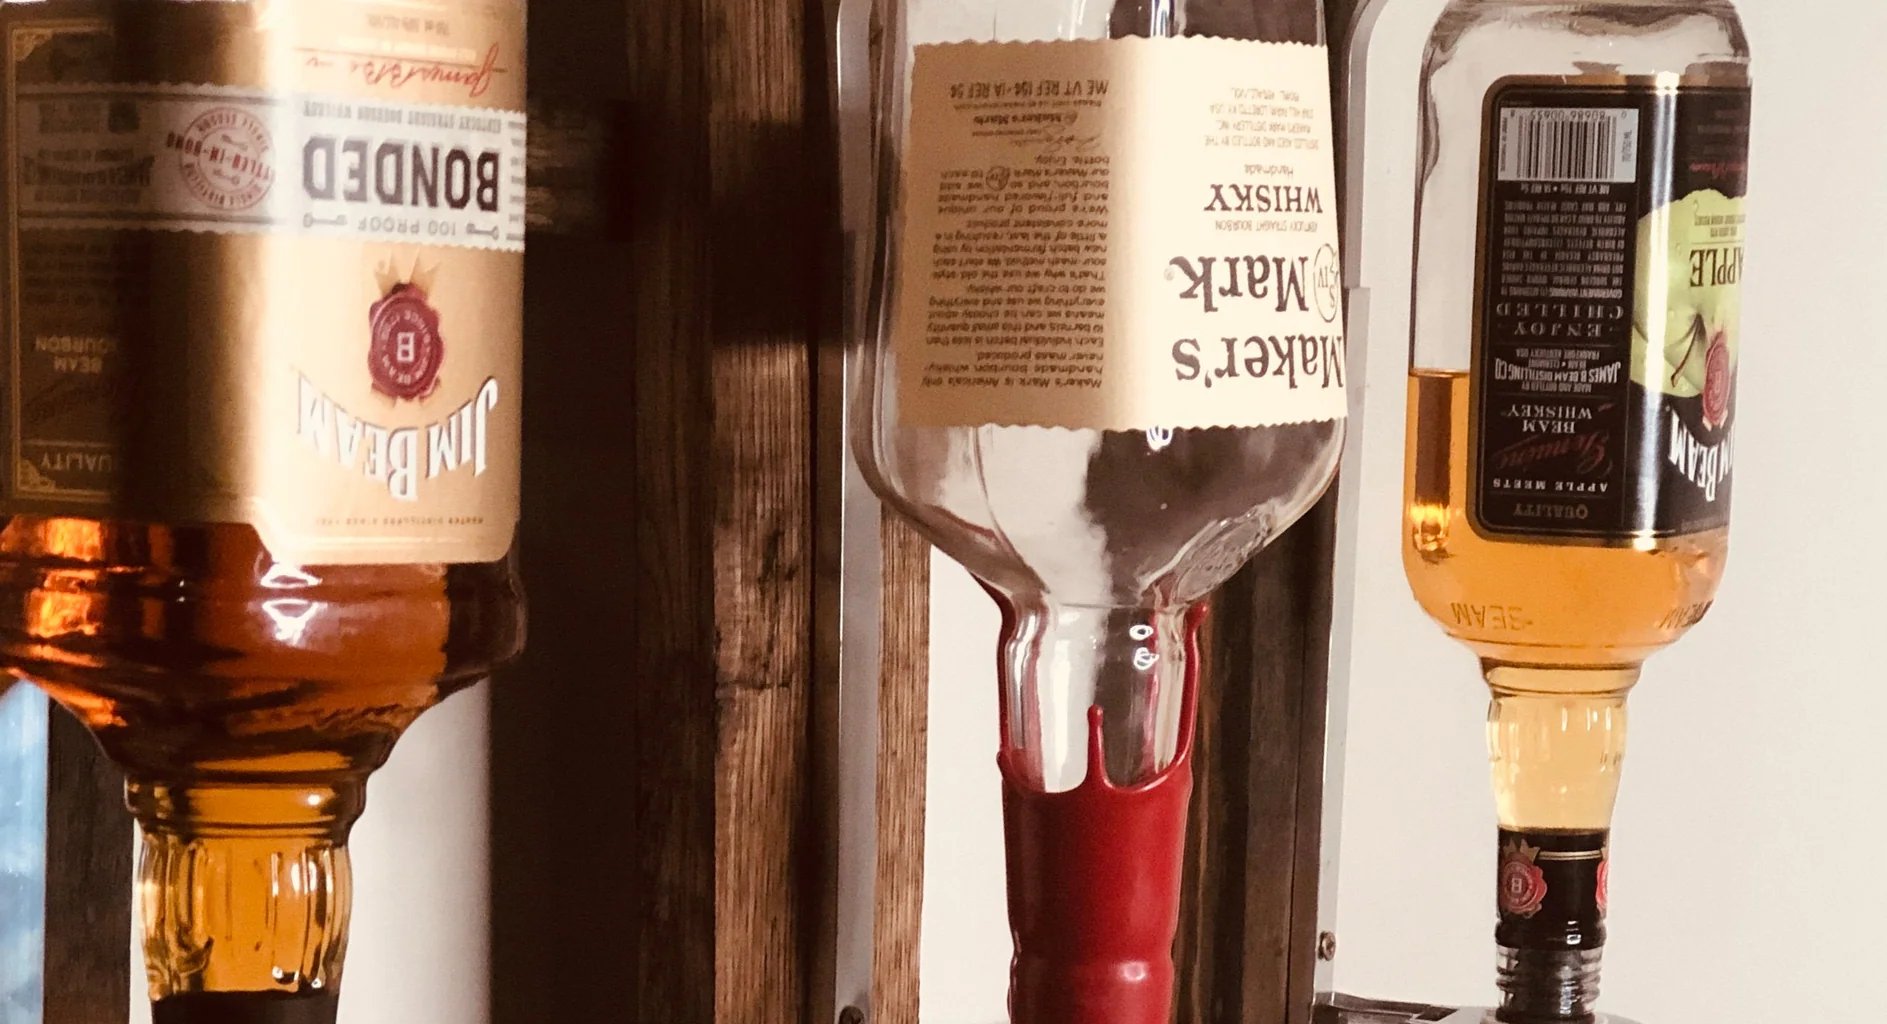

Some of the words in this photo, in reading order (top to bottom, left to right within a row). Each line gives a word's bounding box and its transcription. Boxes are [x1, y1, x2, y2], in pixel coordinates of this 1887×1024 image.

[967, 82, 990, 98] REF
[994, 82, 1005, 97] IA
[1037, 80, 1059, 96] REF
[1064, 80, 1082, 95] VT
[1088, 80, 1107, 96] ME
[303, 137, 500, 212] BONDED
[1244, 164, 1293, 177] Handmade
[938, 193, 999, 201] handmade
[1083, 193, 1108, 201] and
[1204, 184, 1322, 214] WHISKY
[938, 205, 976, 214] unique
[984, 205, 1004, 214] our
[1010, 205, 1023, 214] of
[1029, 204, 1066, 213] proud
[1072, 205, 1108, 214] We're
[358, 217, 420, 234] PROOF
[428, 220, 456, 236] 100
[1690, 246, 1744, 287] APPLE
[1168, 255, 1309, 313] Mark
[929, 297, 980, 306] everything
[983, 297, 1002, 306] and
[1007, 297, 1024, 306] use
[1028, 297, 1041, 306] we
[1045, 297, 1105, 306] everything
[1496, 303, 1624, 319] CHILLED
[927, 322, 970, 332] quantity
[972, 323, 999, 333] small
[1003, 323, 1021, 333] this
[1025, 323, 1046, 333] and
[1050, 323, 1091, 333] barrels
[1514, 321, 1602, 337] ENJOY
[926, 336, 949, 346] than
[975, 336, 982, 346] is
[985, 336, 1017, 346] batch
[1020, 336, 1073, 346] individual
[1076, 336, 1103, 346] Each
[396, 332, 414, 362] B
[1035, 352, 1067, 360] mass
[1069, 352, 1103, 360] never
[1171, 334, 1343, 388] Maker's
[974, 364, 1028, 373] bourbon
[1034, 365, 1103, 374] handmade
[1508, 364, 1552, 381] DISTILLING
[1588, 361, 1621, 383] JAMES
[1555, 371, 1578, 382] BEAM
[922, 377, 943, 388] only
[948, 377, 999, 388] America's
[1005, 377, 1014, 388] is
[1020, 377, 1050, 388] Mark
[1055, 377, 1102, 388] Maker's
[1507, 404, 1592, 419] WHISKEY
[425, 377, 497, 479] JIM
[1522, 420, 1575, 434] BEAM
[297, 372, 418, 502] BEAM
[1495, 432, 1607, 476] Genuine
[1668, 412, 1718, 502] BEAM
[40, 452, 113, 472] UALITY
[1492, 478, 1545, 490] MEETS
[1555, 481, 1608, 492] APPLE
[1513, 503, 1588, 519] QUALITY
[1512, 878, 1523, 893] B
